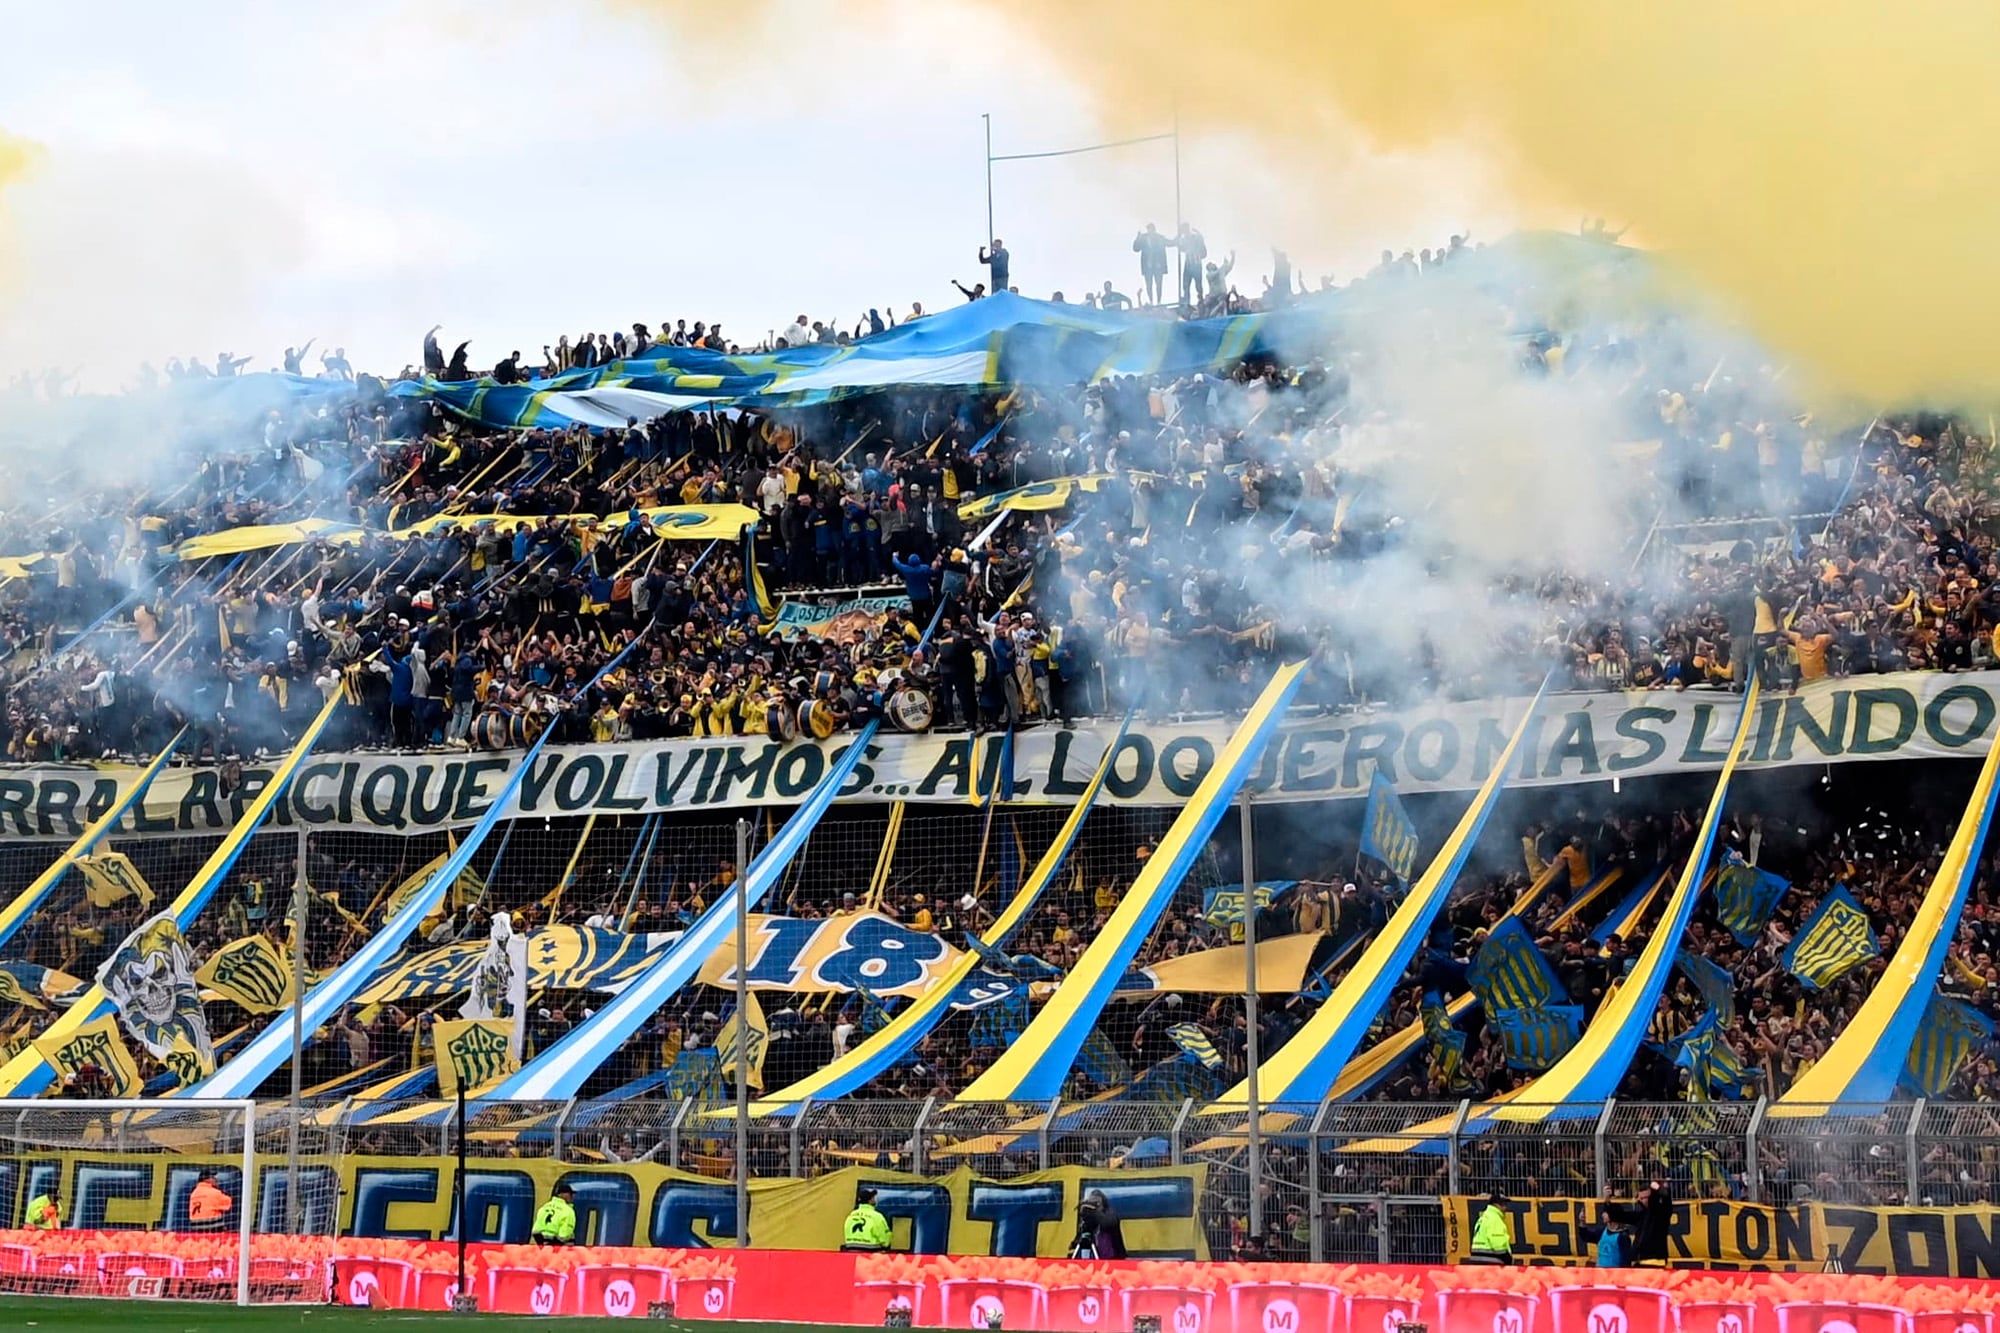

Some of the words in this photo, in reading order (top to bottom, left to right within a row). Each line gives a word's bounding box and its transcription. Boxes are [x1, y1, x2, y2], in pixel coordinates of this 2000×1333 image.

[361, 759, 510, 830] QUE
[1679, 685, 1996, 762] LINDO
[450, 1027, 506, 1056] CARC
